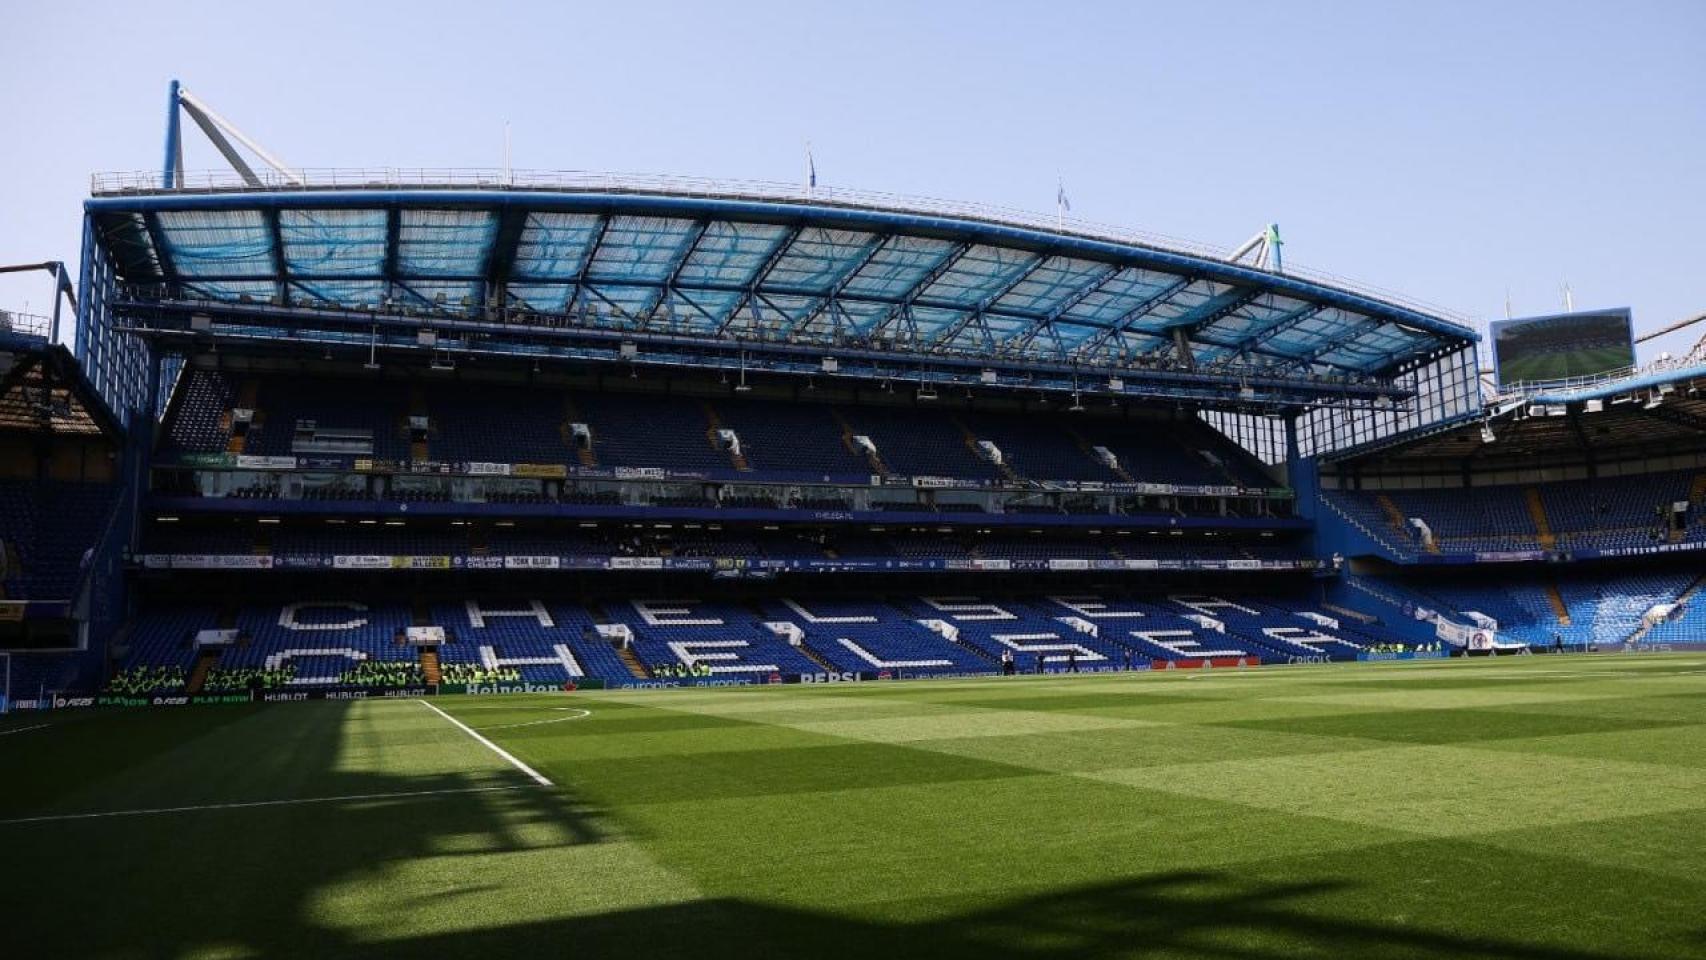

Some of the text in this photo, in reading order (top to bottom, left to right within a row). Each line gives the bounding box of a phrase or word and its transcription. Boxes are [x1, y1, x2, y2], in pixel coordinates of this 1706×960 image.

[801, 671, 861, 684] PEPSI
[384, 688, 426, 698] HUBLOT
[466, 682, 559, 695] Heineken
[325, 691, 368, 700] HUBLOT
